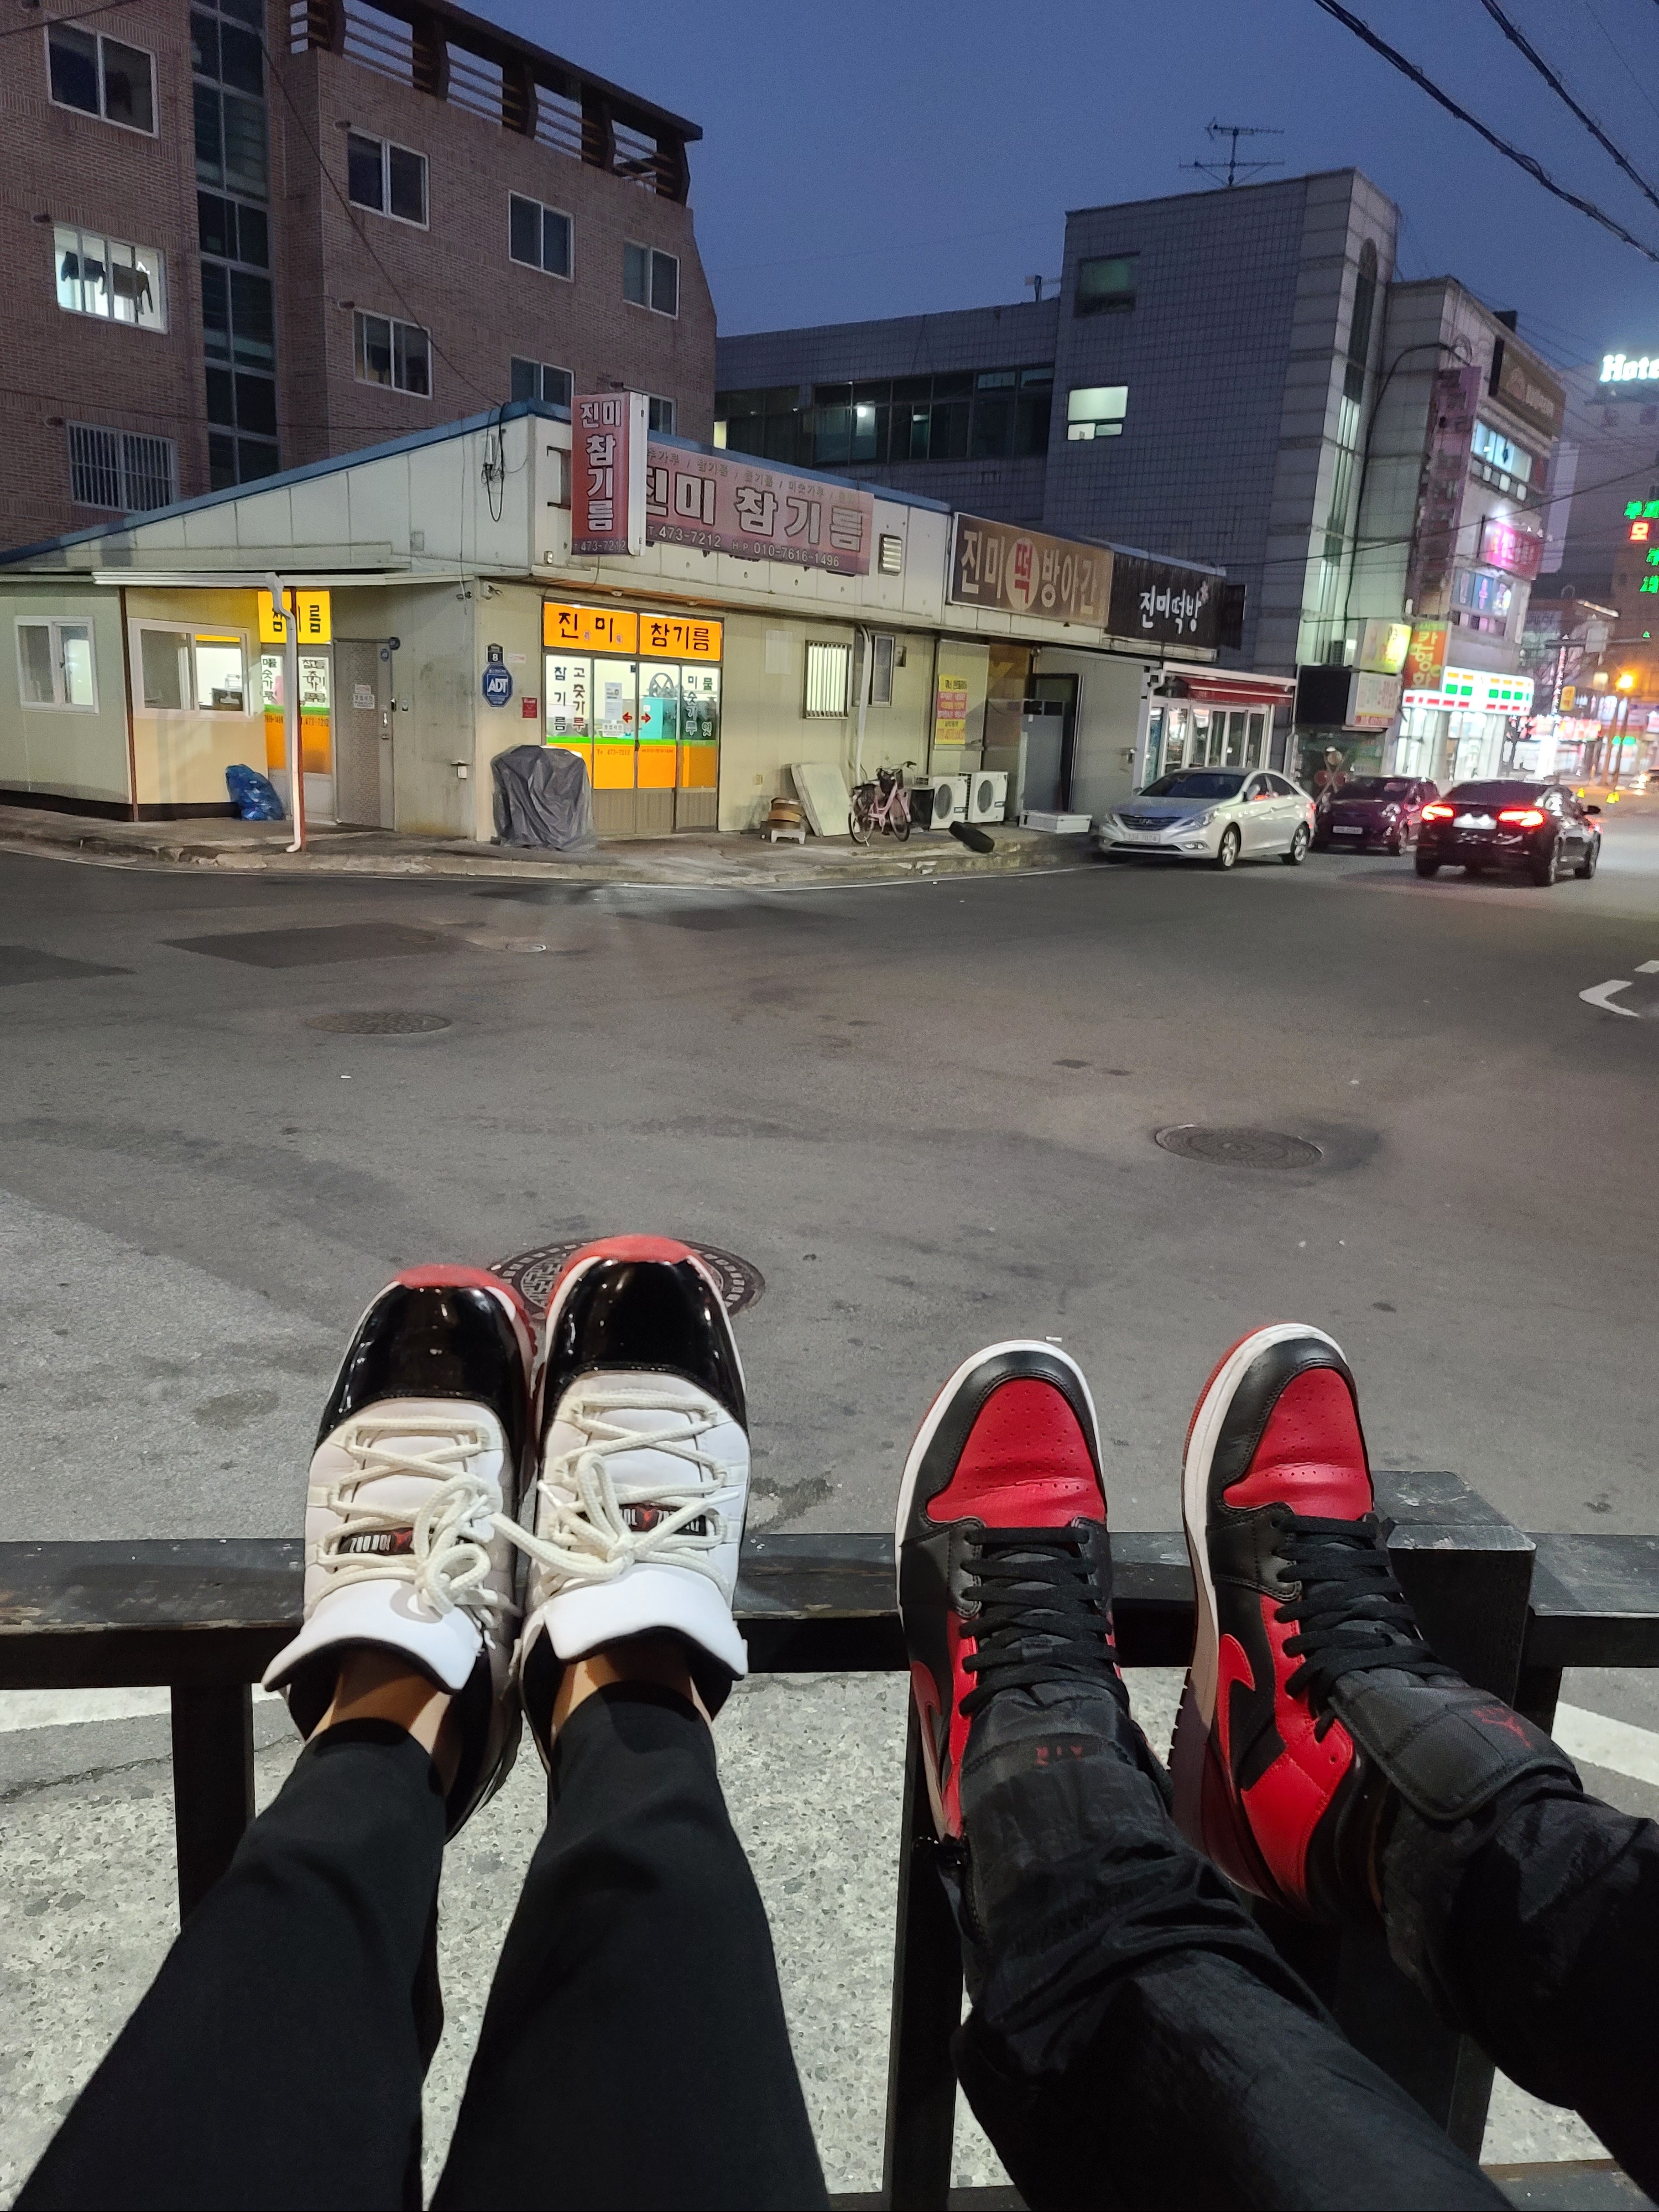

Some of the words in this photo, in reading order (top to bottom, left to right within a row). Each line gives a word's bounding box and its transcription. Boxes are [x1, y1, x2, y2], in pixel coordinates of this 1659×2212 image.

[580, 399, 621, 429] 진미
[585, 433, 615, 531] 참기름
[734, 486, 863, 552] 참기름
[754, 541, 839, 567] 010-7616-1496
[1140, 585, 1202, 634] 진미떡방
[559, 612, 613, 644] 진미
[651, 623, 709, 651] 참기름
[492, 653, 498, 661] 8
[487, 678, 508, 693] ADT
[554, 666, 567, 731] 참기름
